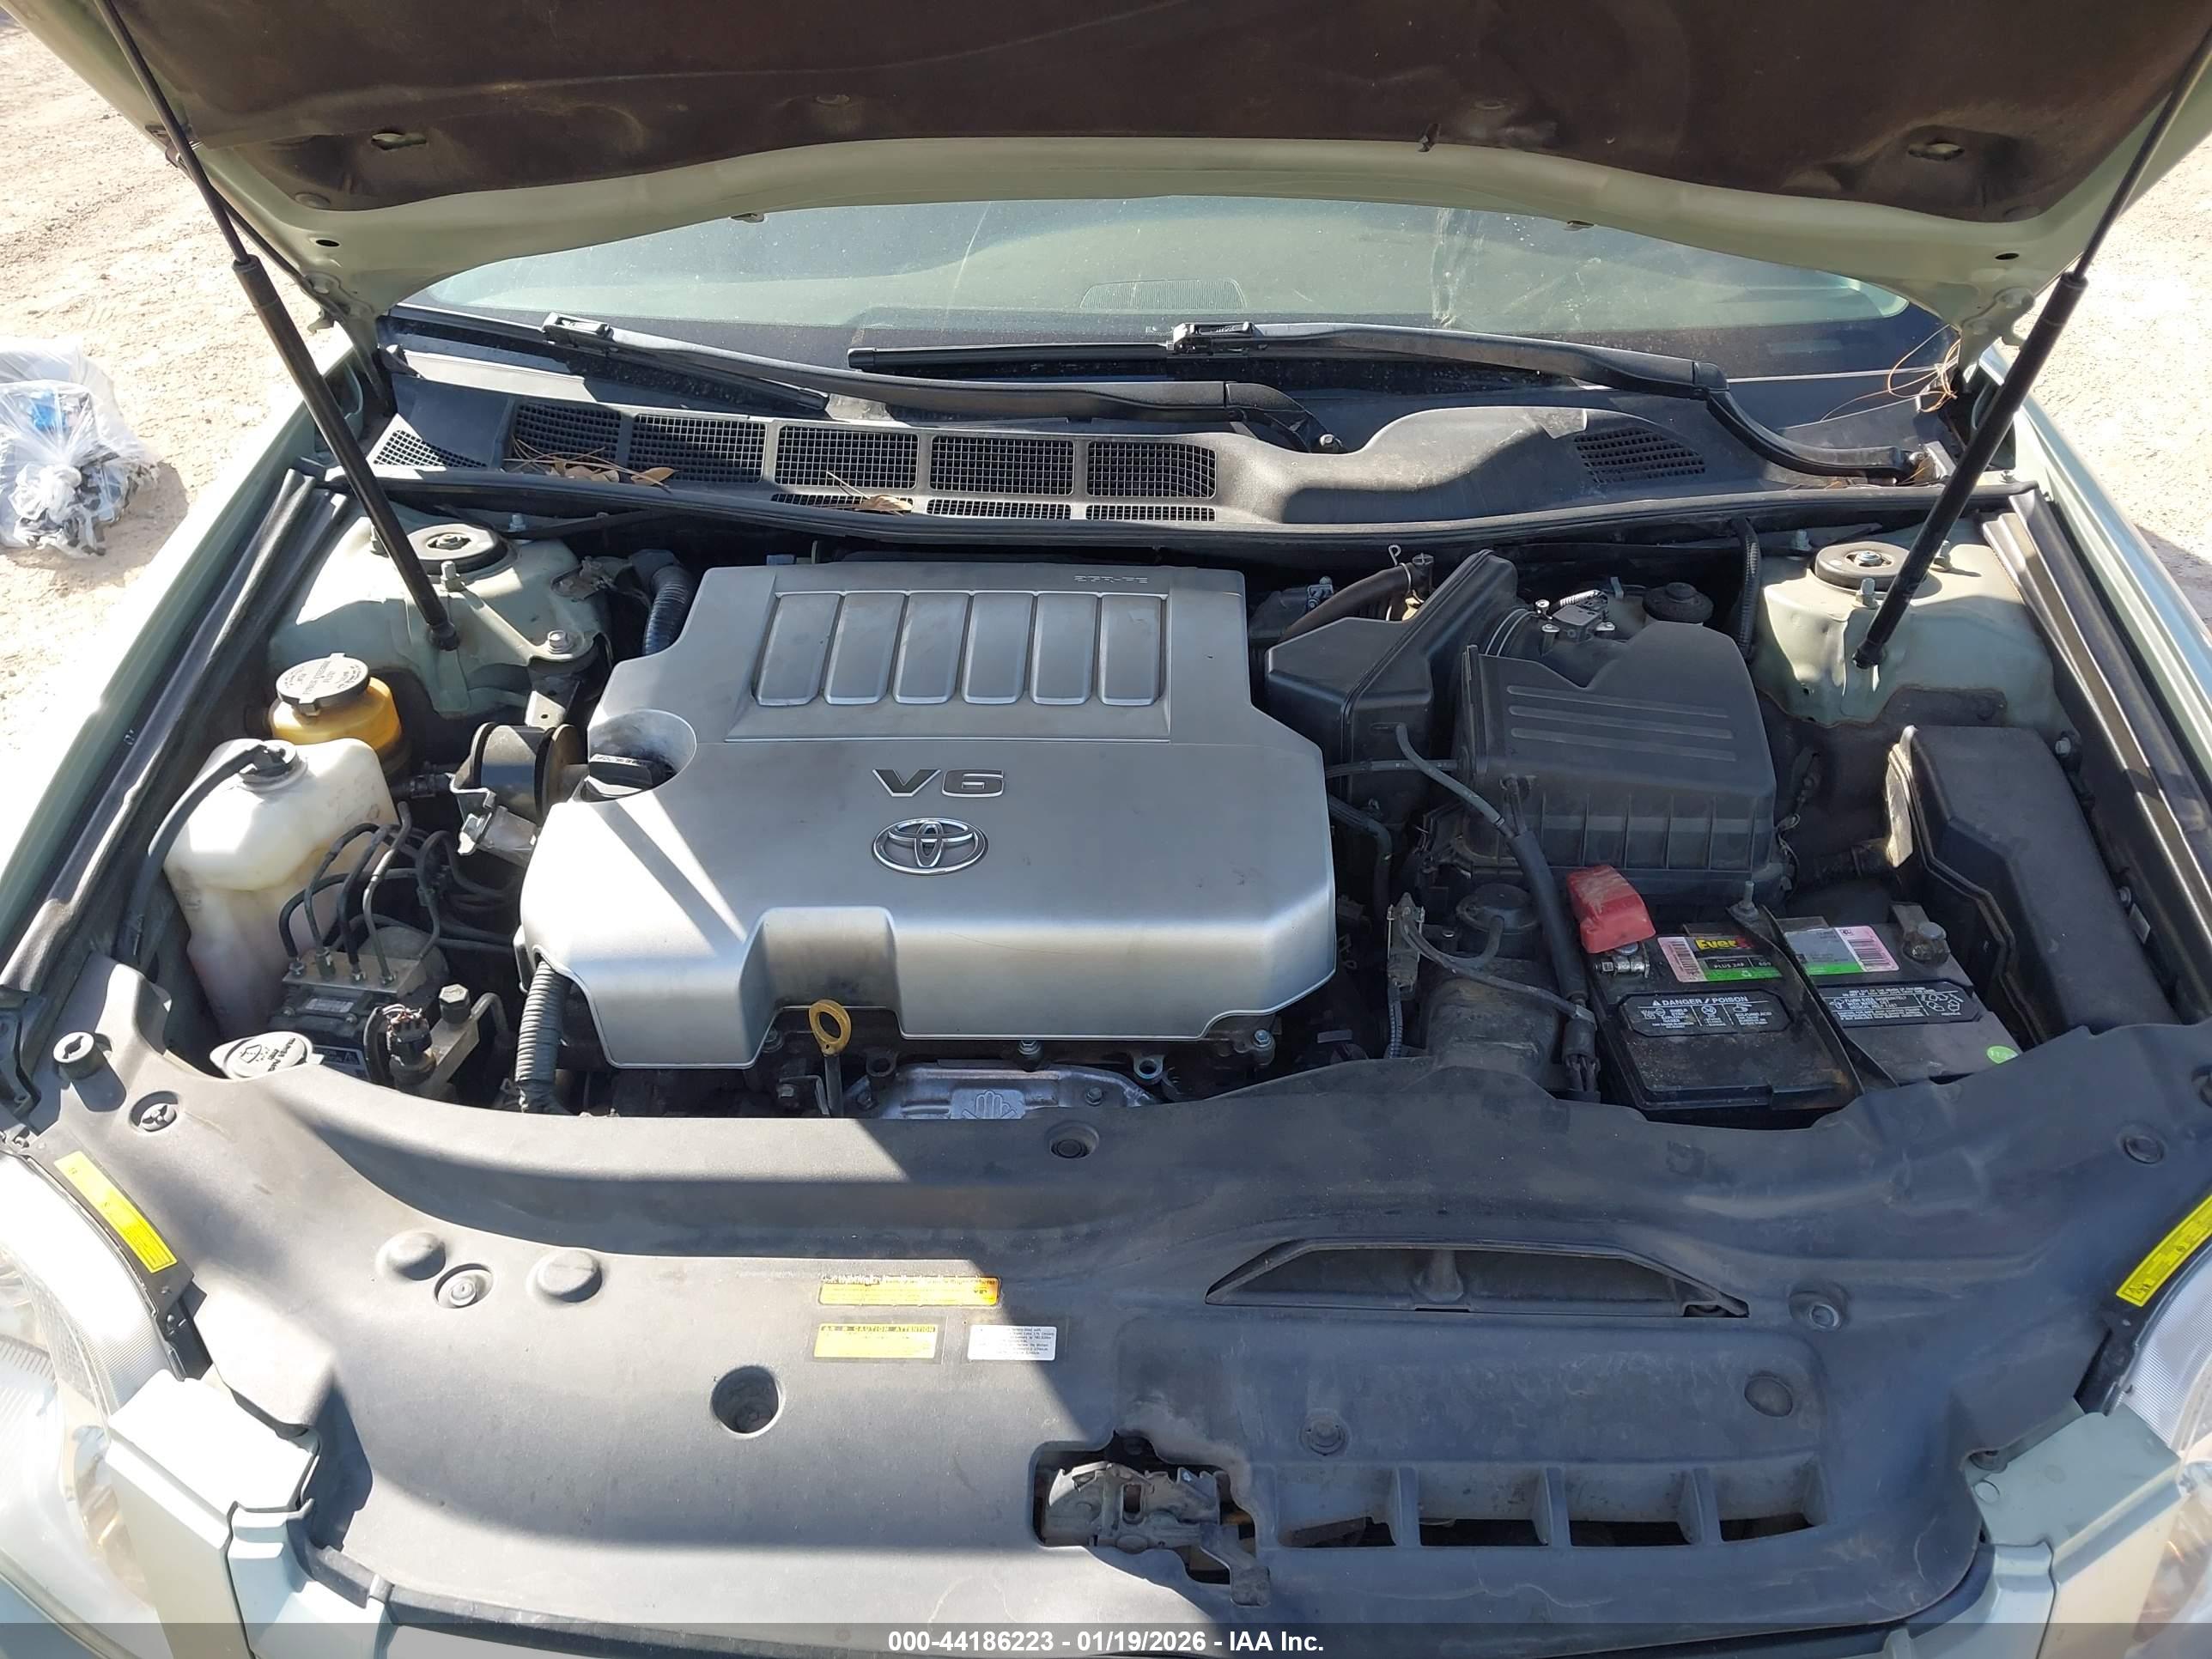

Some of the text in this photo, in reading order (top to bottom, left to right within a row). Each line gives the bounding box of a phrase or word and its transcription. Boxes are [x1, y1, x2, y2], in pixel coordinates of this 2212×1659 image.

[872, 769, 1004, 798] V6
[1662, 998, 1702, 1006] DANGER
[1712, 995, 1749, 1004] POISON
